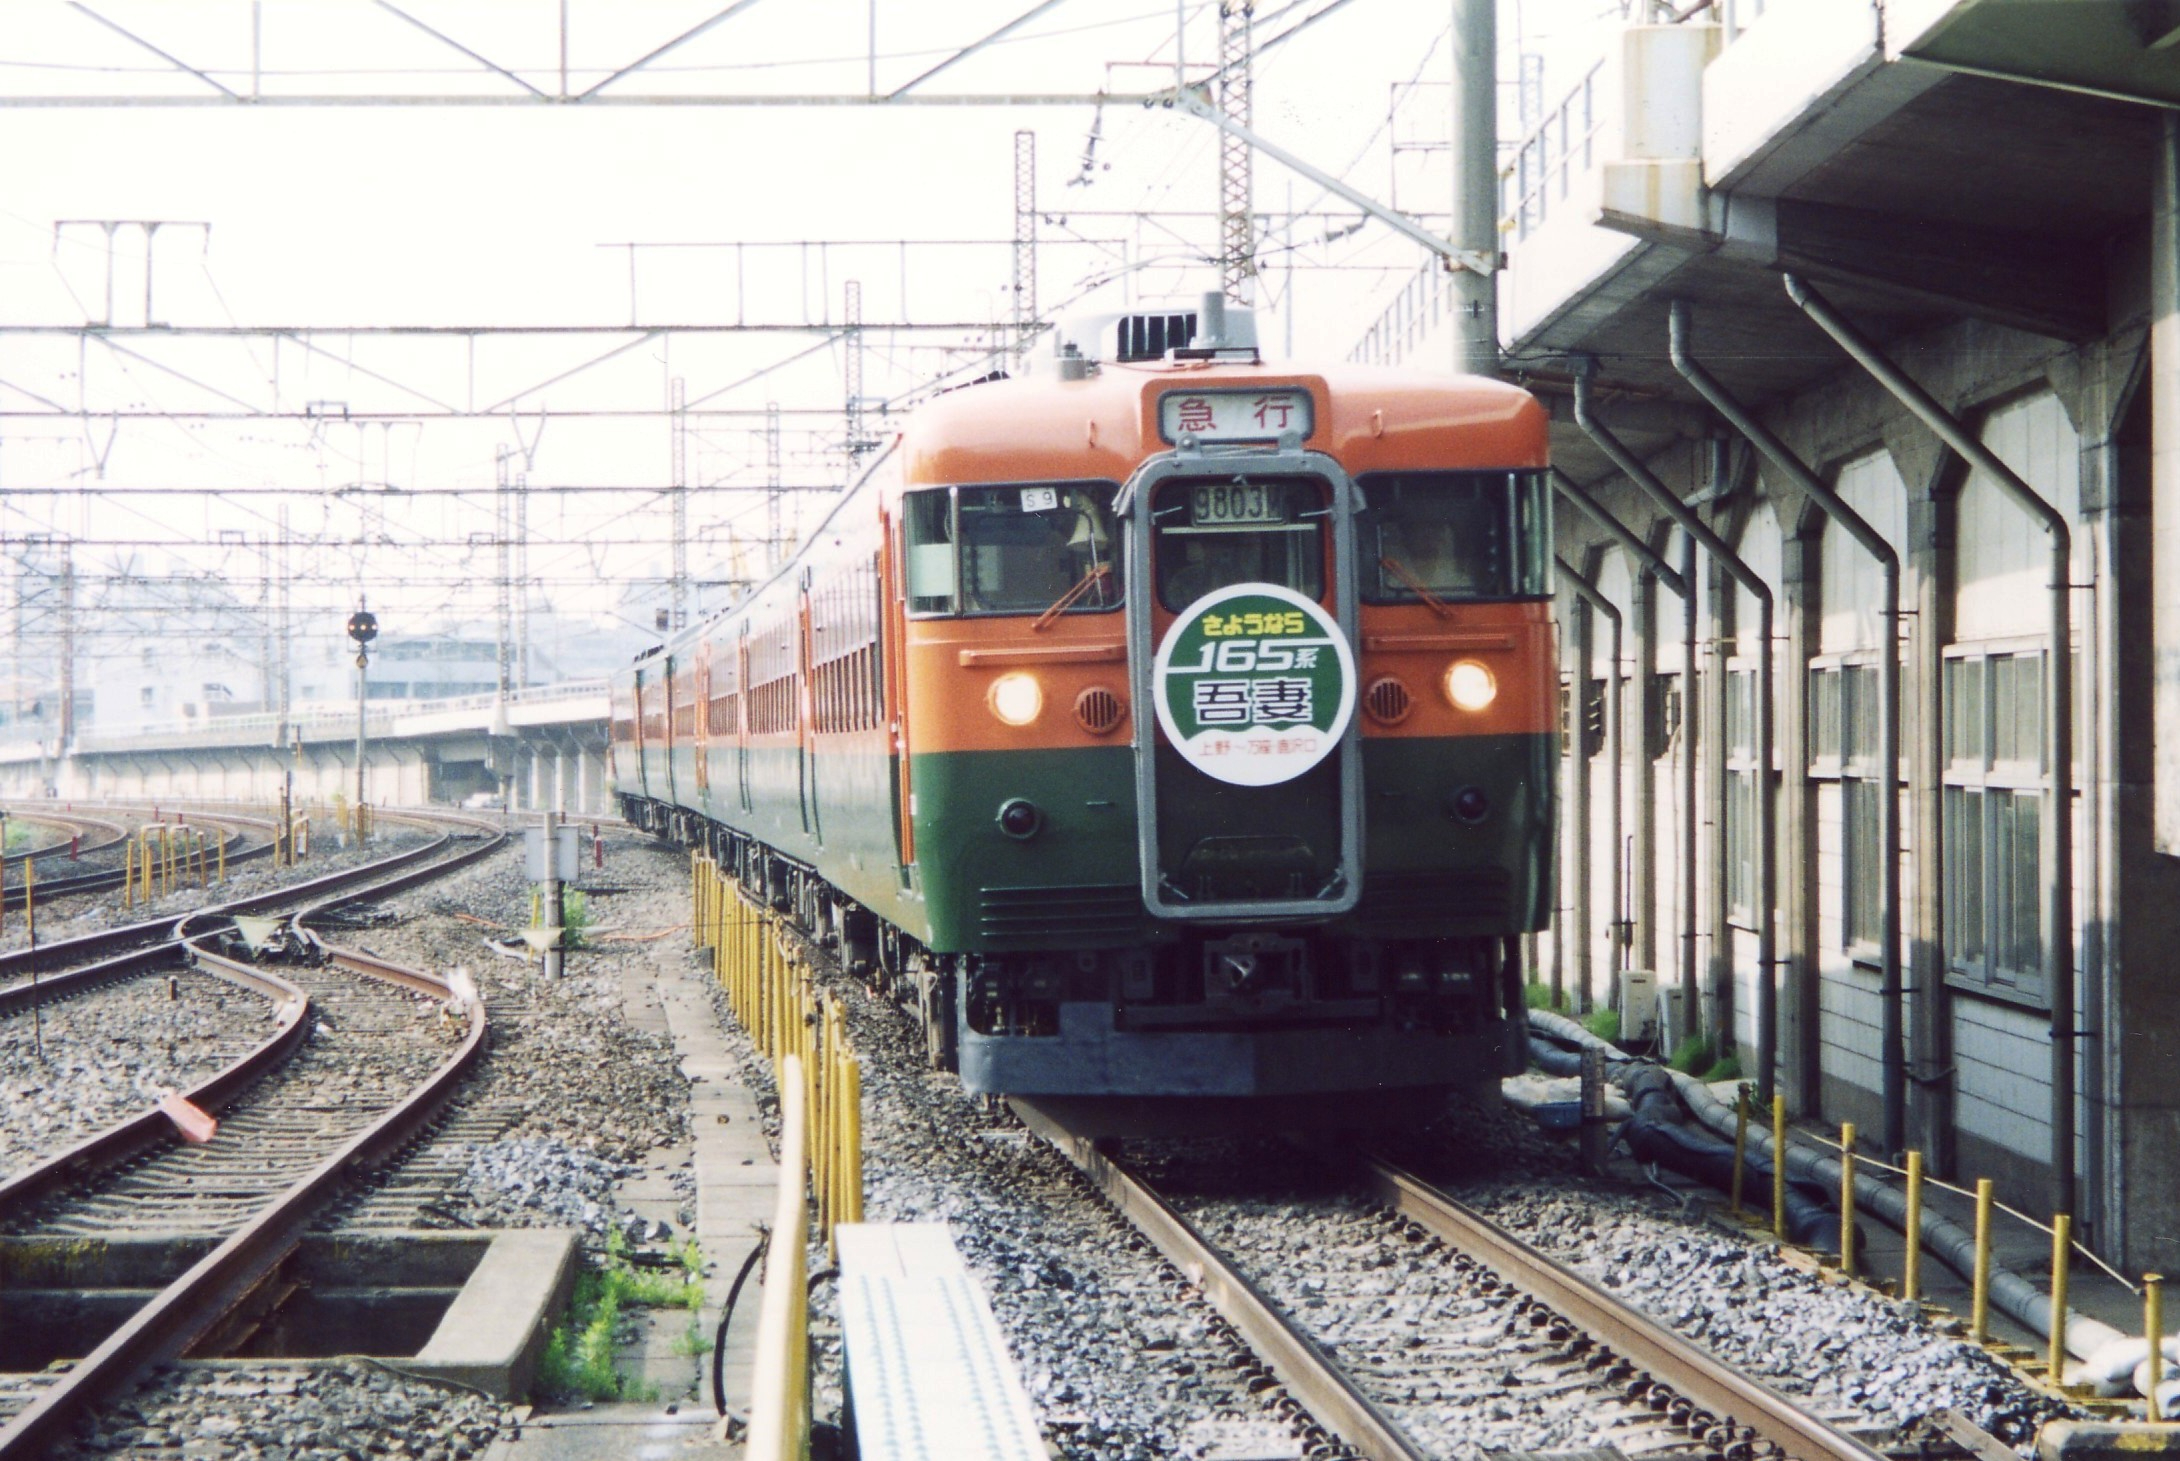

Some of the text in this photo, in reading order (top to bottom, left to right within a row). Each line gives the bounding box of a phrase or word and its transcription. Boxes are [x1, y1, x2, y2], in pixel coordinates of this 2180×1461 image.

[1178, 396, 1294, 431] 急行
[1202, 612, 1305, 636] さようなら
[1199, 638, 1319, 673] 165系
[1193, 677, 1313, 725] 吾妻
